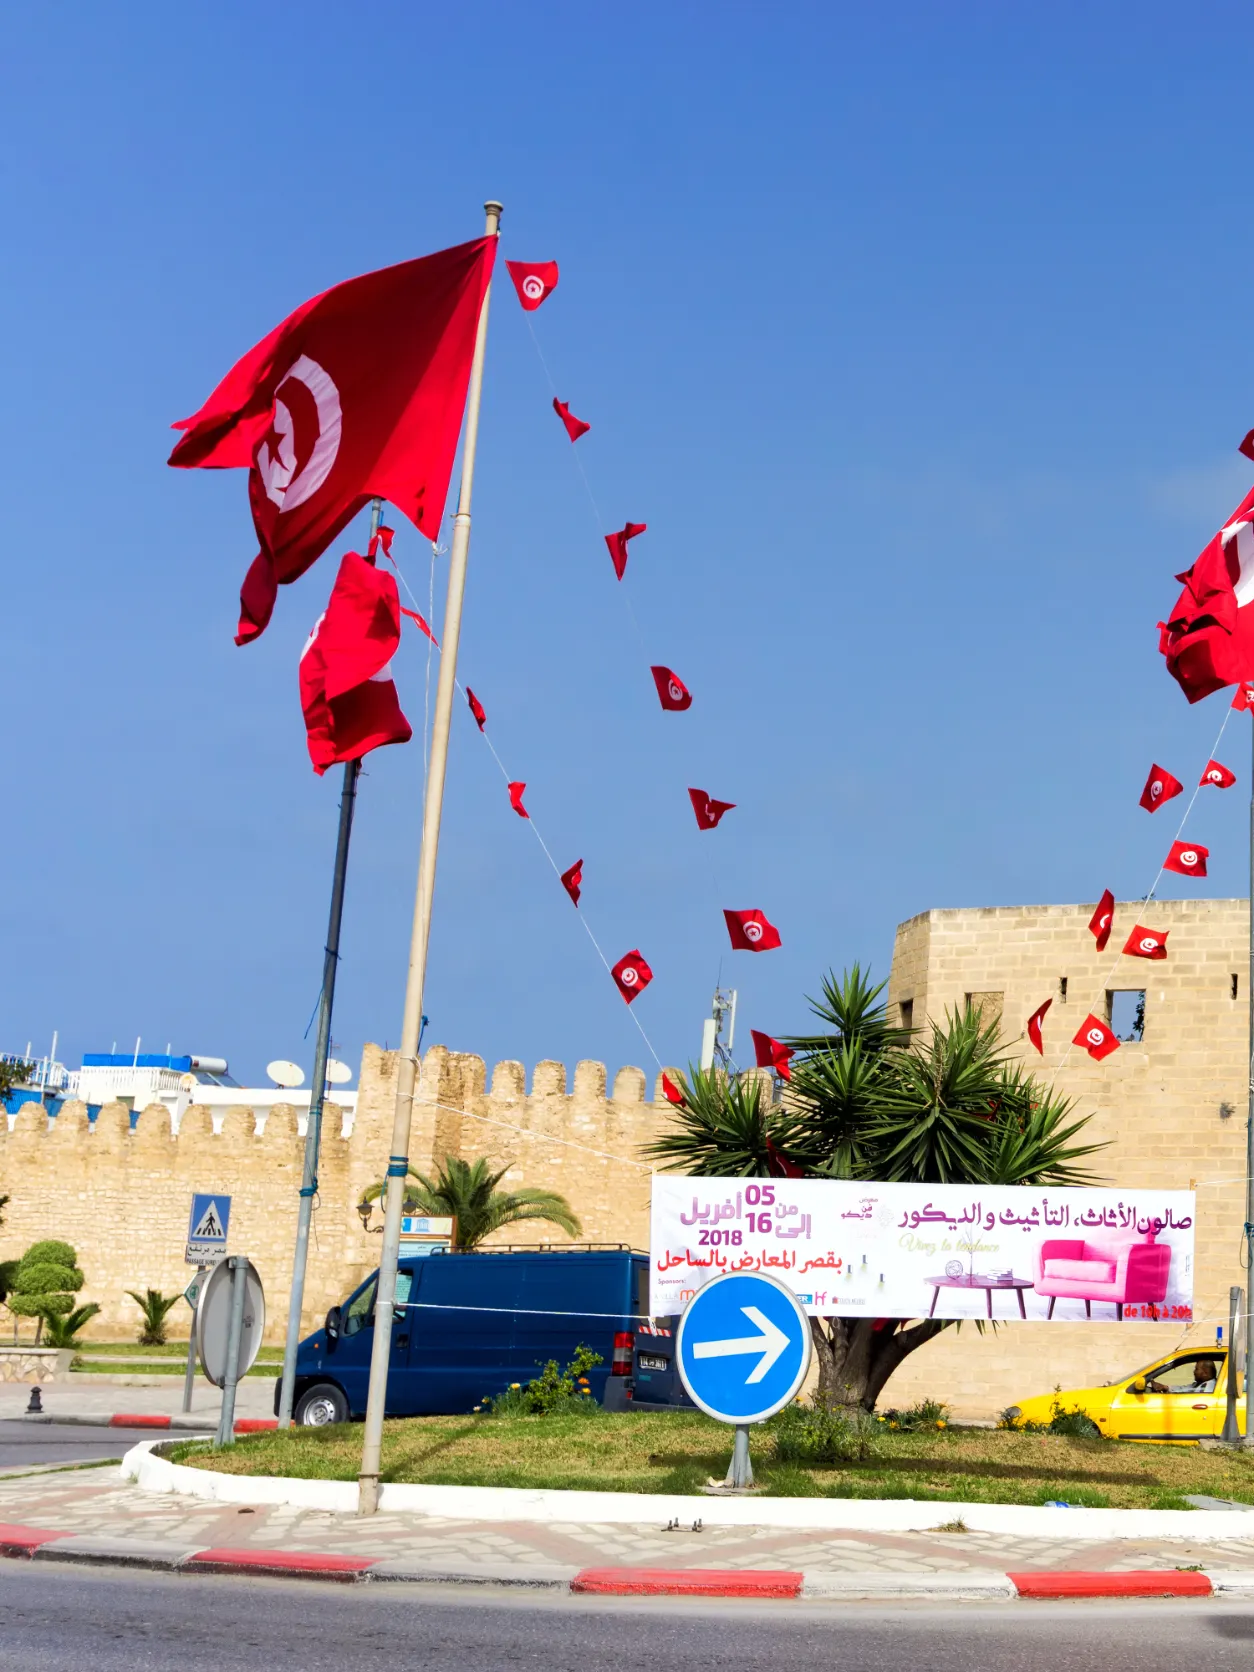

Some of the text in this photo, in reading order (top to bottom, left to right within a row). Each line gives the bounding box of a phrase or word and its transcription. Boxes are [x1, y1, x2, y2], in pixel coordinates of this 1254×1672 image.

[745, 1184, 775, 1206] 05
[680, 1191, 742, 1225] أفريل
[775, 1202, 799, 1219] من
[745, 1212, 773, 1233] 16
[775, 1214, 812, 1239] إلى
[1137, 1208, 1192, 1236] صالون
[698, 1230, 743, 1246] 2018
[657, 1249, 843, 1275] بقصر المعارض بالساحل
[1124, 1304, 1138, 1318] de
